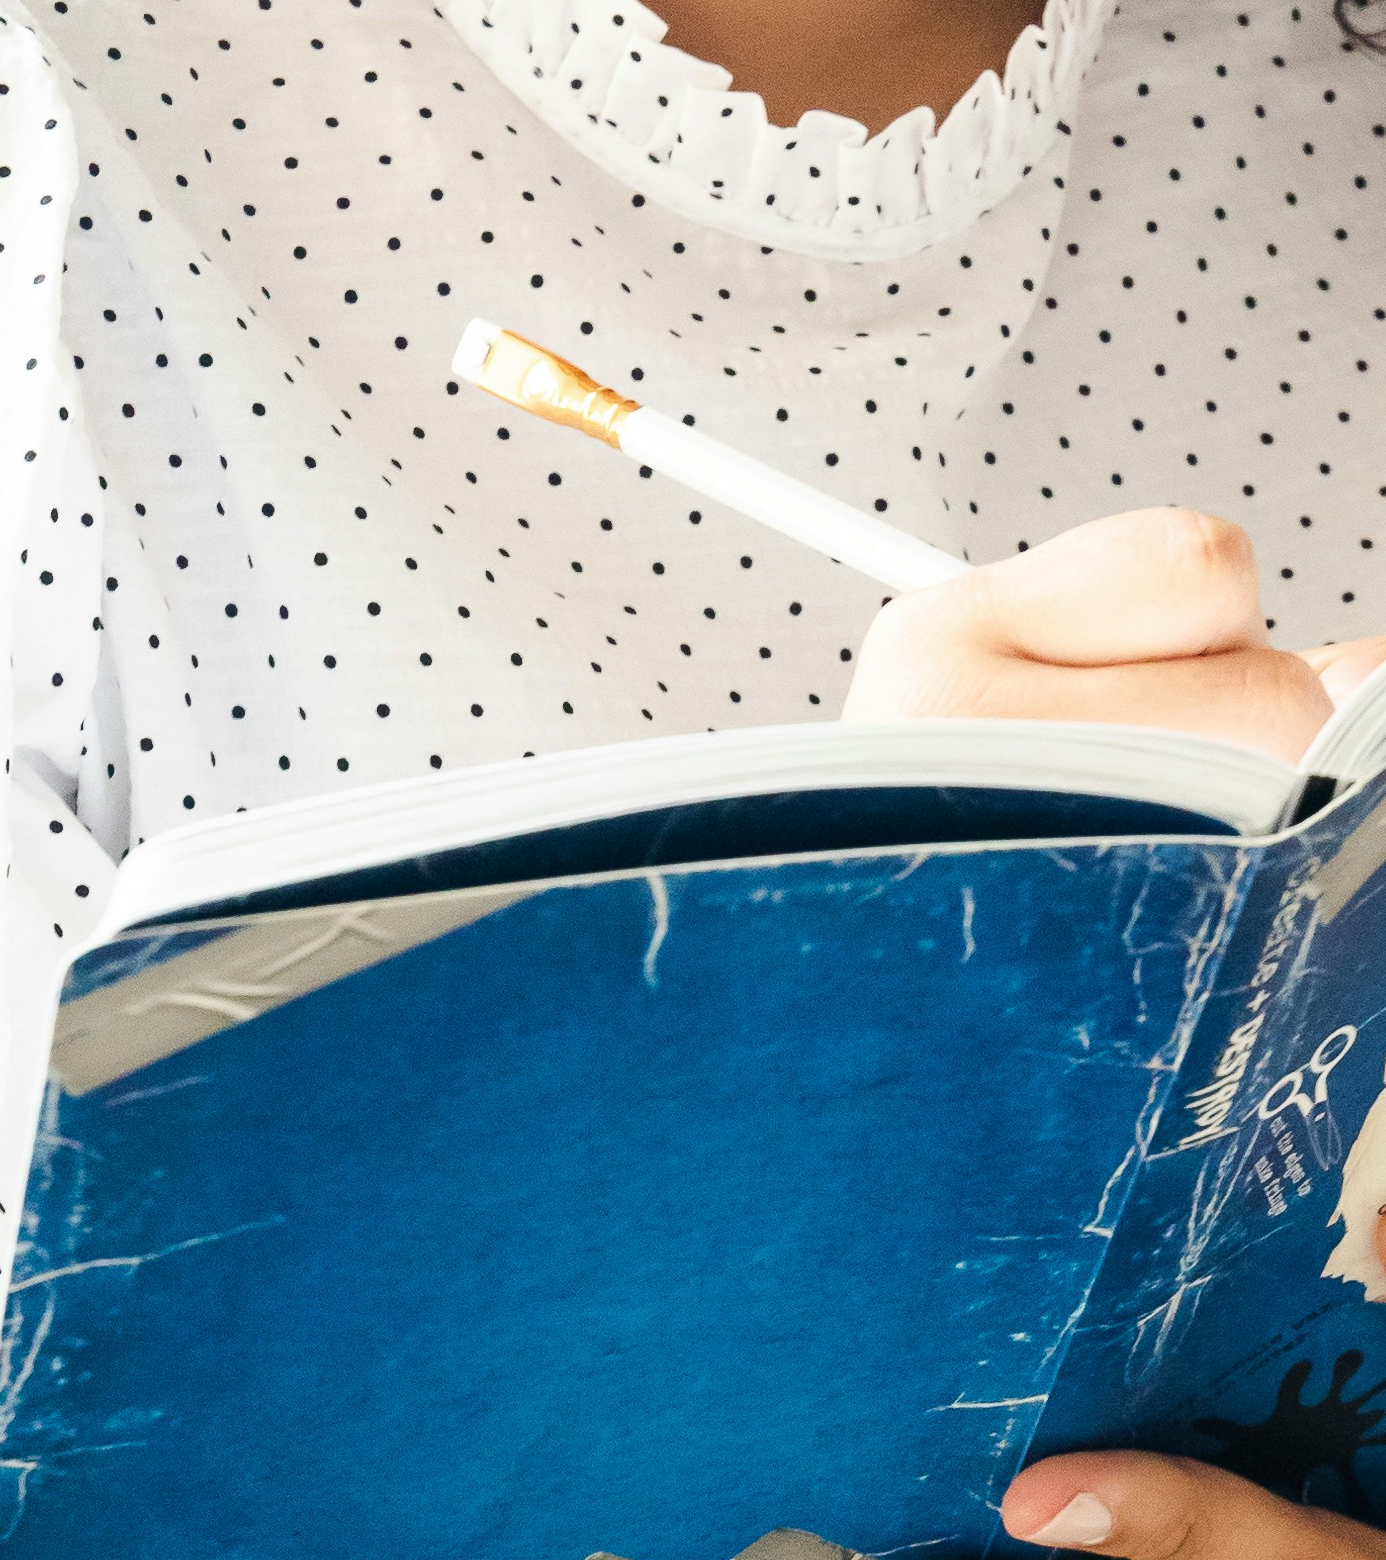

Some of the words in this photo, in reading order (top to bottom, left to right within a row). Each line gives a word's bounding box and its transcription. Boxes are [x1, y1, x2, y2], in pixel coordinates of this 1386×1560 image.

[1179, 1012, 1265, 1148] DESTROY
[1277, 1130, 1294, 1156] the
[1297, 1177, 1313, 1197] to
